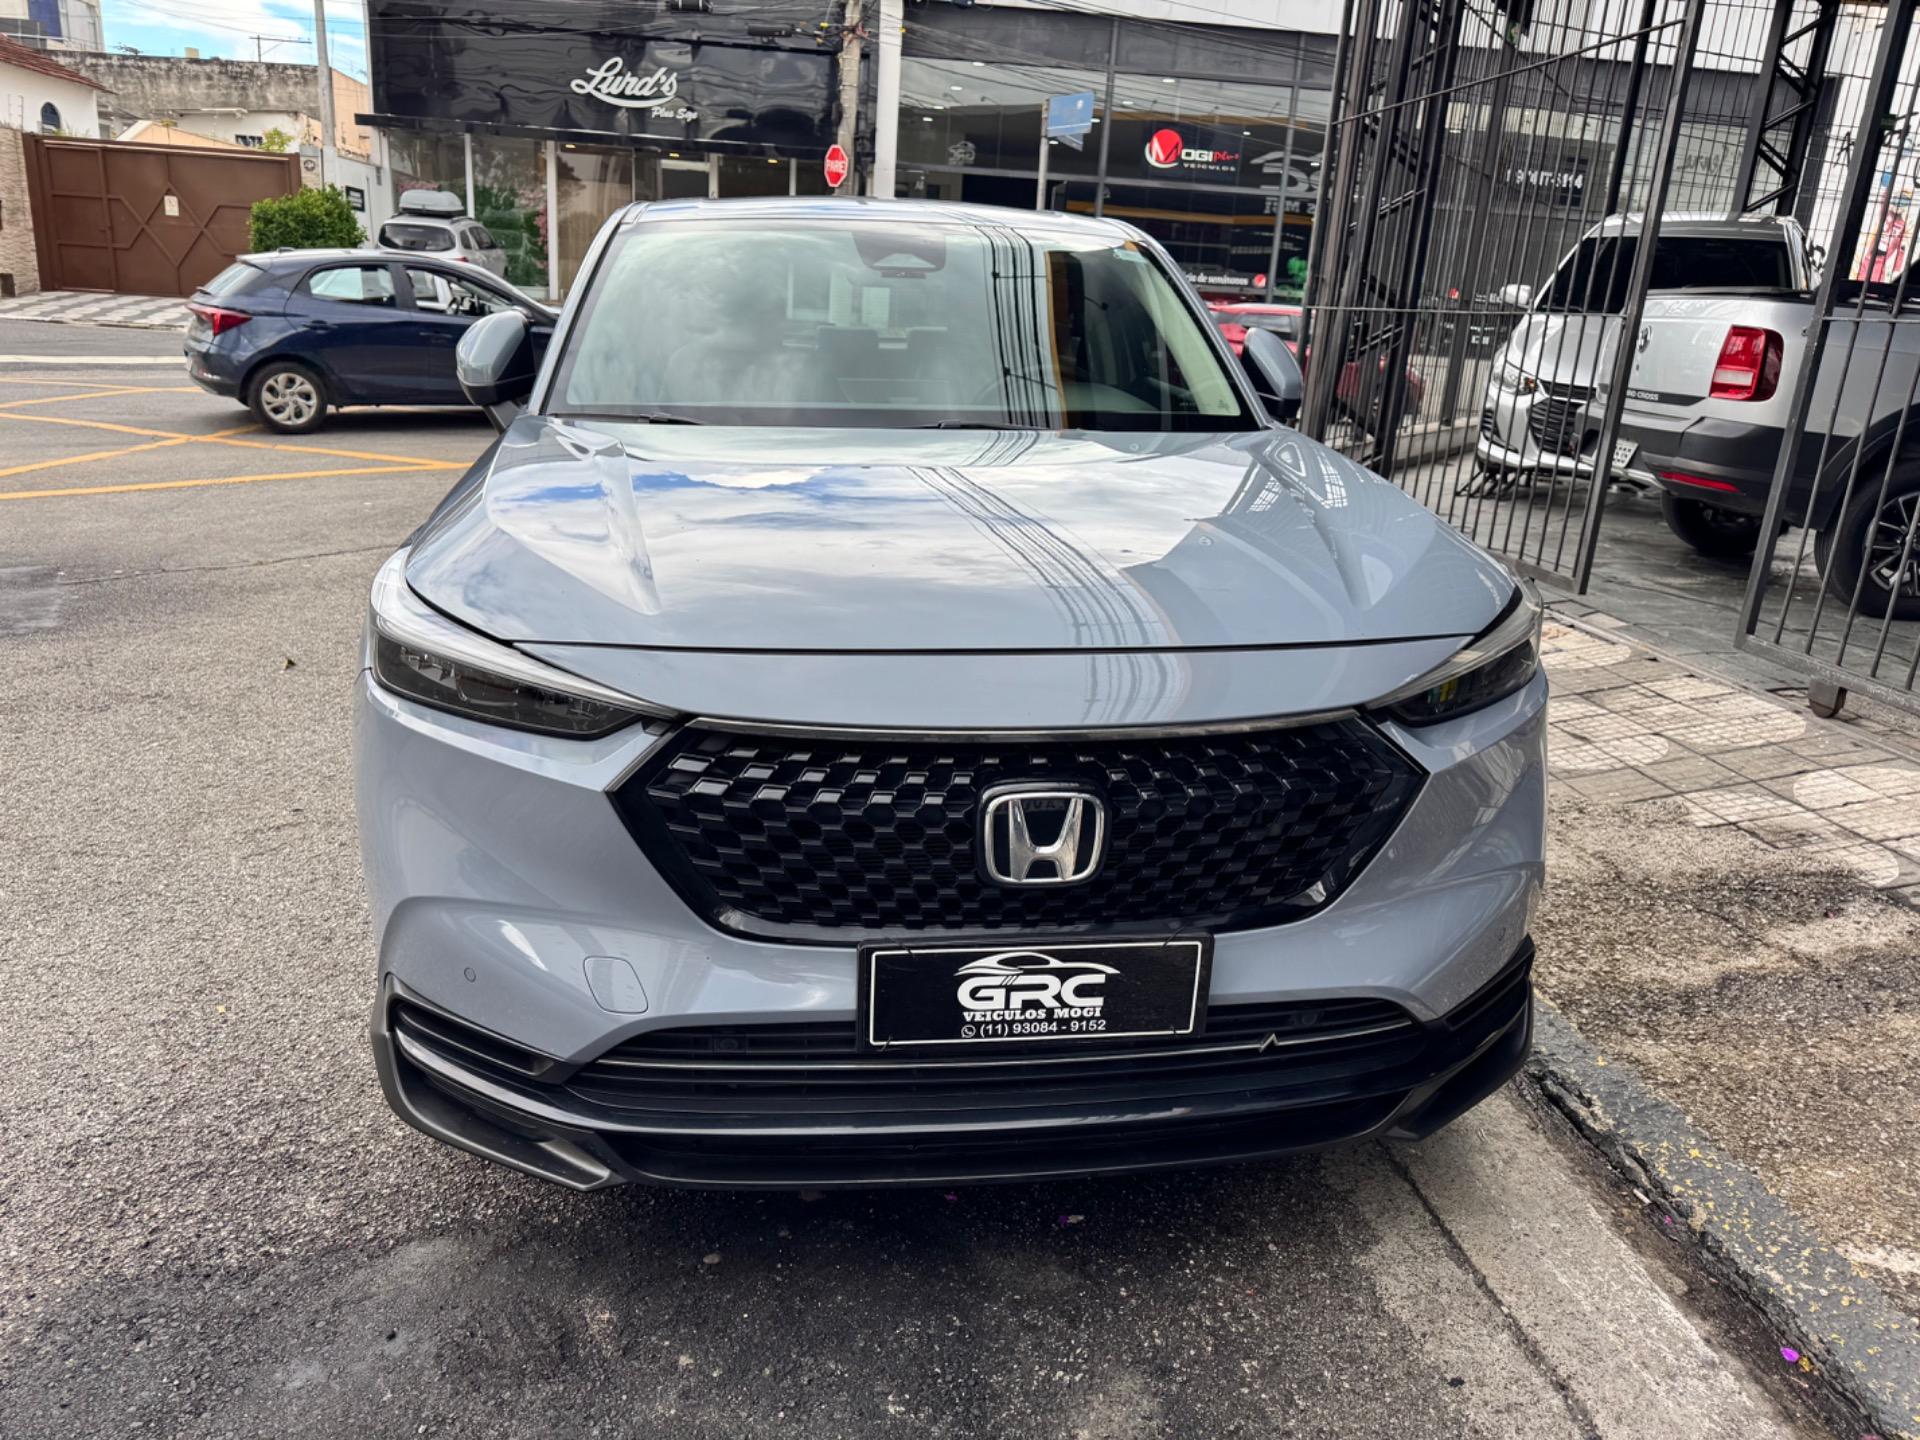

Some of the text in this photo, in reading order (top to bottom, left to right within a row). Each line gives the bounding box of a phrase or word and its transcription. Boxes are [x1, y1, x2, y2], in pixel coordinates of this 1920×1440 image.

[570, 56, 679, 108] Lurd's
[826, 159, 847, 173] PARE
[957, 973, 1106, 1011] GRC
[963, 1007, 1102, 1022] VEICULOS MOGI
[979, 1023, 1009, 1038] (11)
[1013, 1021, 1058, 1034] 93084
[1070, 1019, 1107, 1032] 9152
